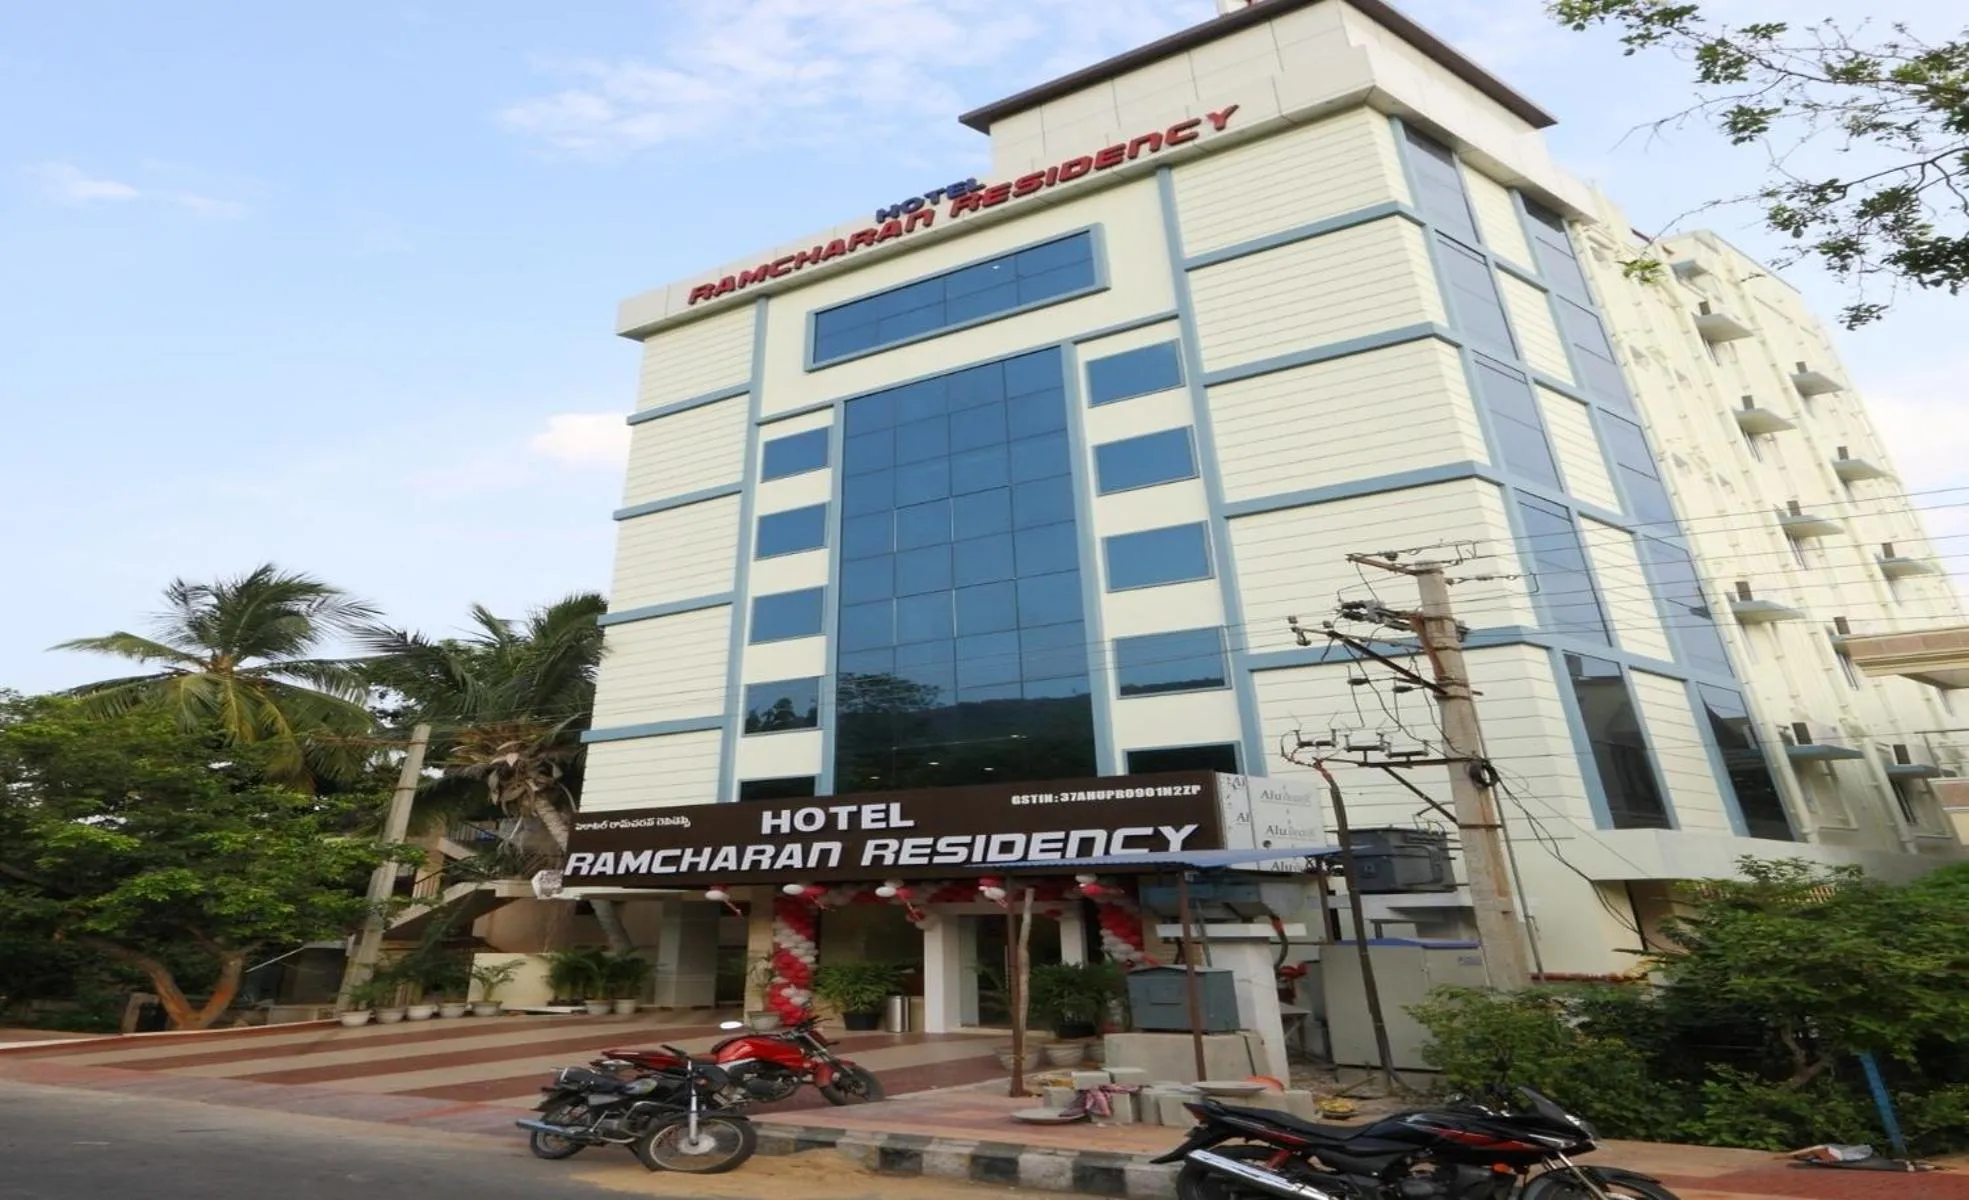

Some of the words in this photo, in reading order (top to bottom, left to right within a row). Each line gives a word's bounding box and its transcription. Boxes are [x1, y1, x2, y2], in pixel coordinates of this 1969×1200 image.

[689, 211, 933, 303] RAMCHARAN
[949, 105, 1240, 217] RESIDENCY
[875, 177, 986, 222] HOTEL
[761, 802, 914, 835] HOTEL
[564, 842, 842, 876] RAMCHARAN
[861, 824, 1198, 867] RESIDENCY
